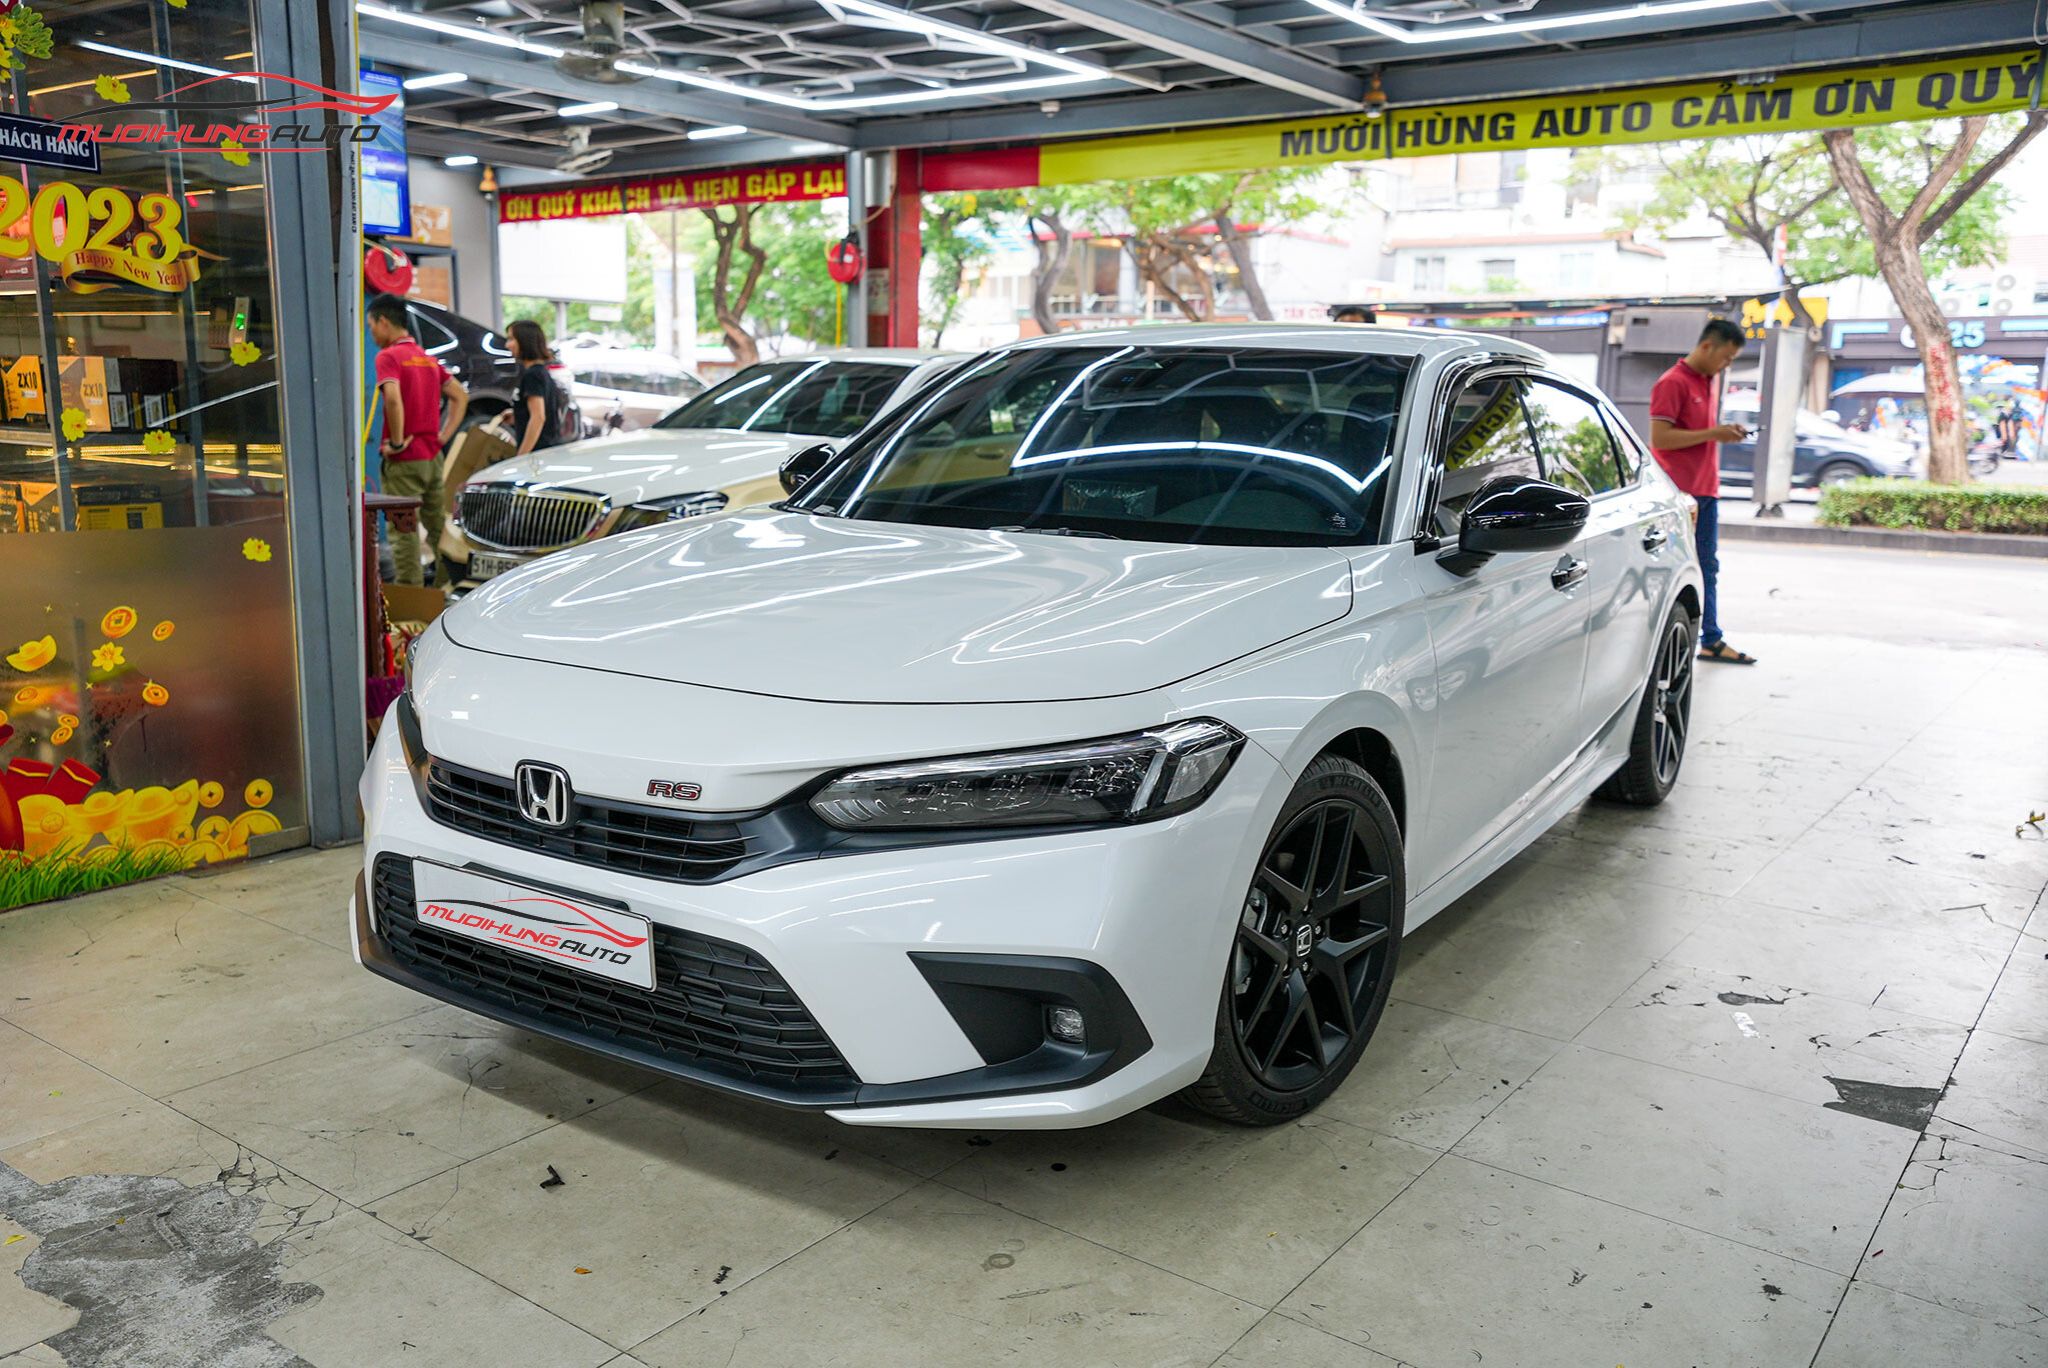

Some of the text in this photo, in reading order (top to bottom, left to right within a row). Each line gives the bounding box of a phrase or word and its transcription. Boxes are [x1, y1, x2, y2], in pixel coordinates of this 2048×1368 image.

[1279, 54, 2040, 157] MƯỜI HÙNG AUTO CẢM ƠN QUÝ
[537, 190, 575, 217] QUÝ
[657, 177, 690, 205] VÀ
[694, 175, 739, 205] HẸN
[746, 168, 797, 201] GẶP
[803, 168, 845, 199] LẠI
[0, 175, 183, 265] 2023
[75, 252, 183, 286] Happy New Year
[17, 371, 38, 389] ZX10
[647, 780, 702, 800] RS
